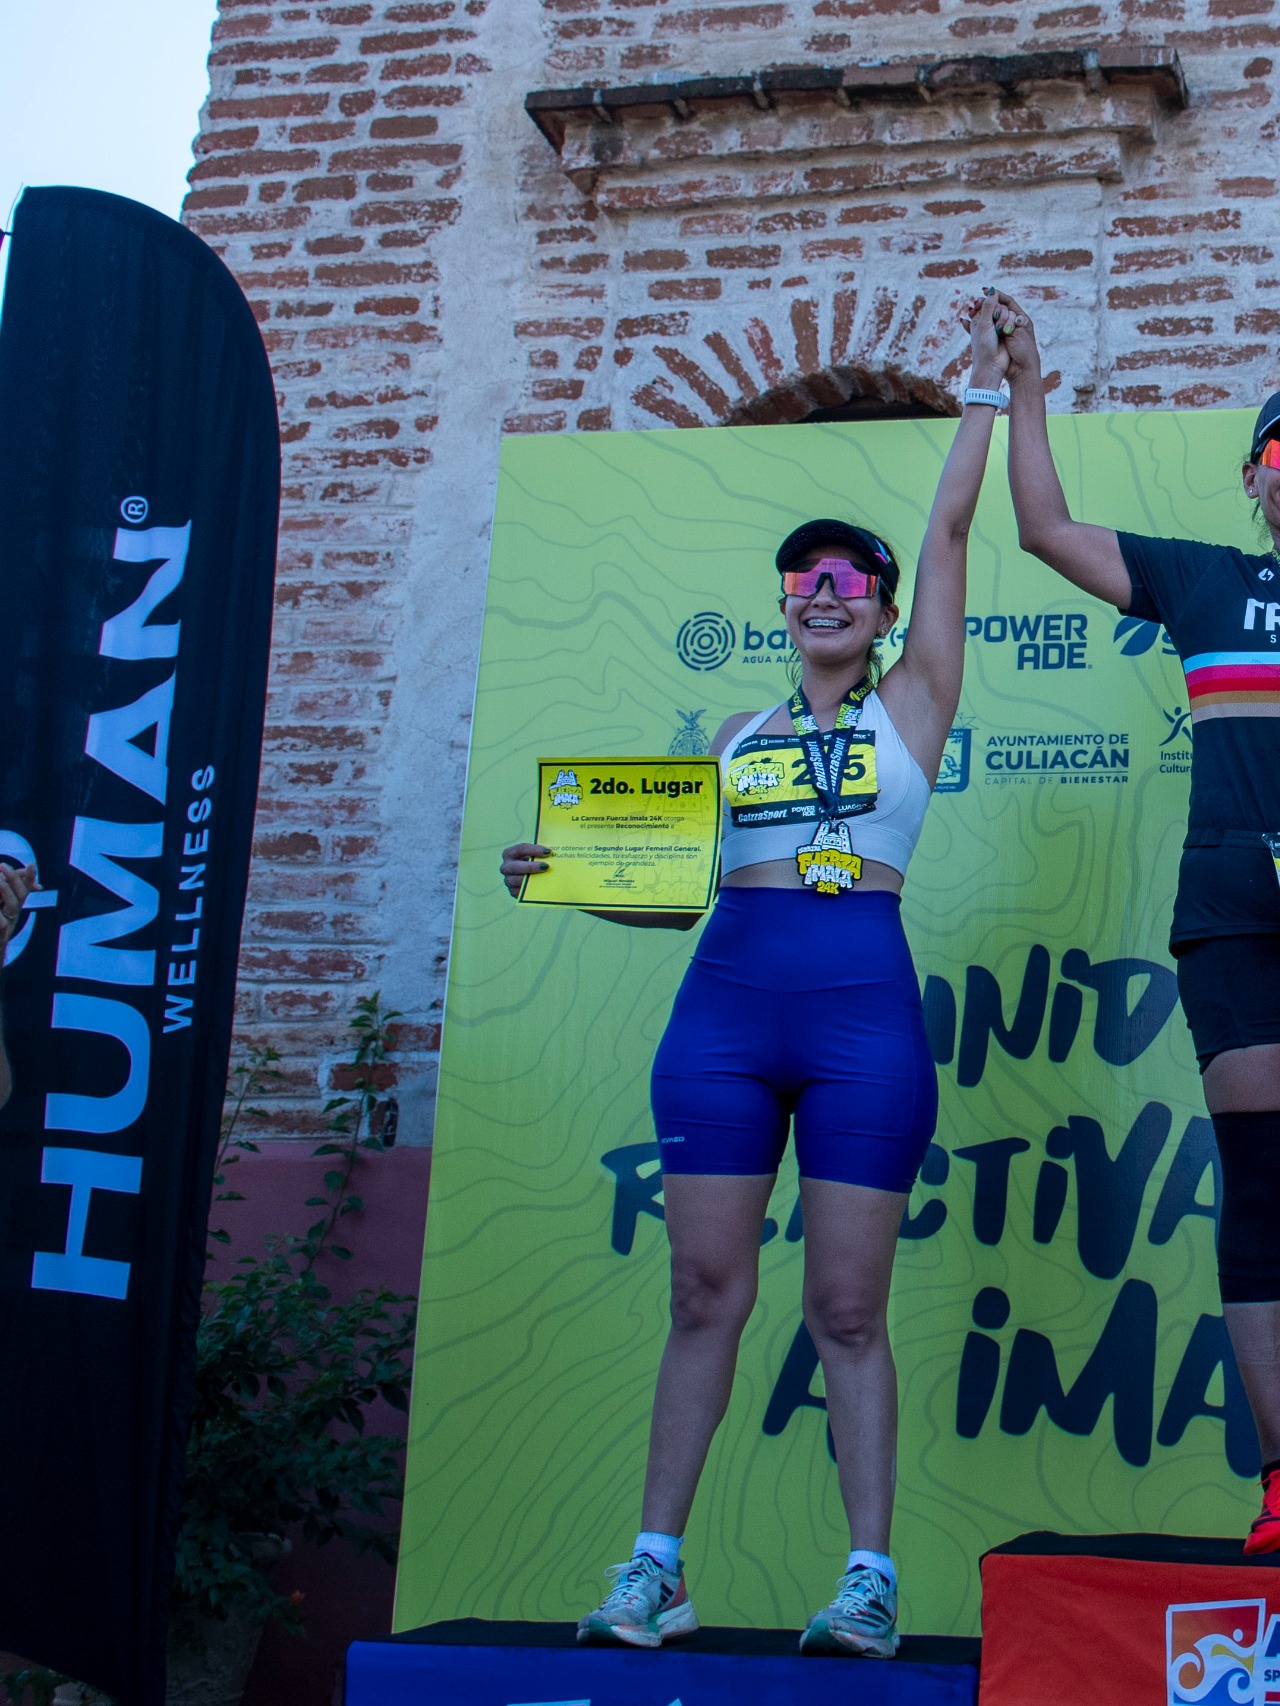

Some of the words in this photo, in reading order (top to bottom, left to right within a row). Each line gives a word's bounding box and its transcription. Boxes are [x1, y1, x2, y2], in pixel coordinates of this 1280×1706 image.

[964, 614, 1088, 643] POWER
[742, 656, 772, 664] AGUA
[987, 734, 1104, 746] AYUNTAMIENTO
[1109, 734, 1128, 744] DE
[985, 746, 1129, 770] CULIACÁN
[791, 754, 867, 787] 25
[984, 777, 1032, 785] CAPITAL
[1060, 776, 1128, 784] BIENESTAR
[590, 778, 635, 794] 2do.
[641, 778, 703, 798] Lugar
[738, 809, 788, 822] CalzzaSport
[162, 765, 216, 1034] WELLNESS
